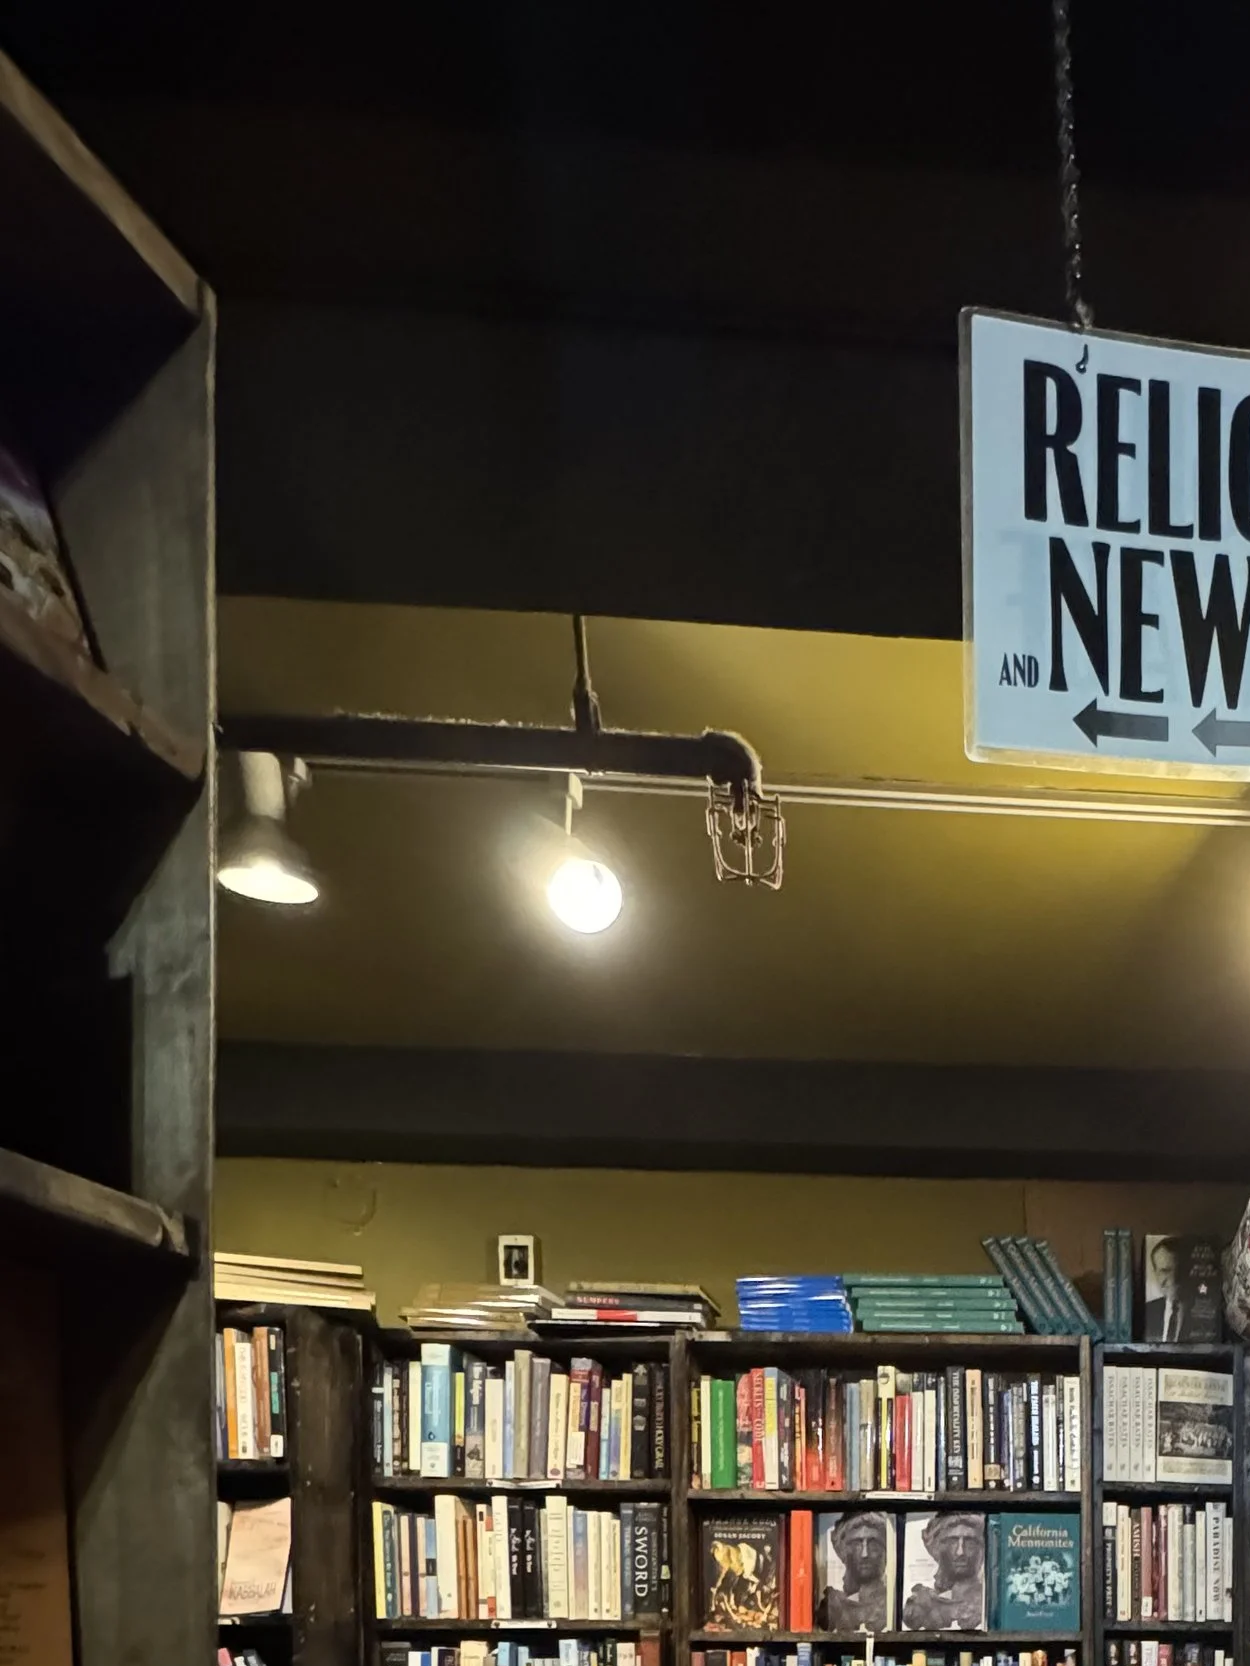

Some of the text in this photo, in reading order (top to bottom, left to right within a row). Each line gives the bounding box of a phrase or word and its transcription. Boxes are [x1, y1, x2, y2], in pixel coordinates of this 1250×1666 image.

[999, 653, 1039, 687] AND
[1007, 1536, 1074, 1548] Mennonites
[1012, 1524, 1068, 1538] California
[1133, 1522, 1141, 1557] AMISH
[635, 1526, 649, 1597] SWORD
